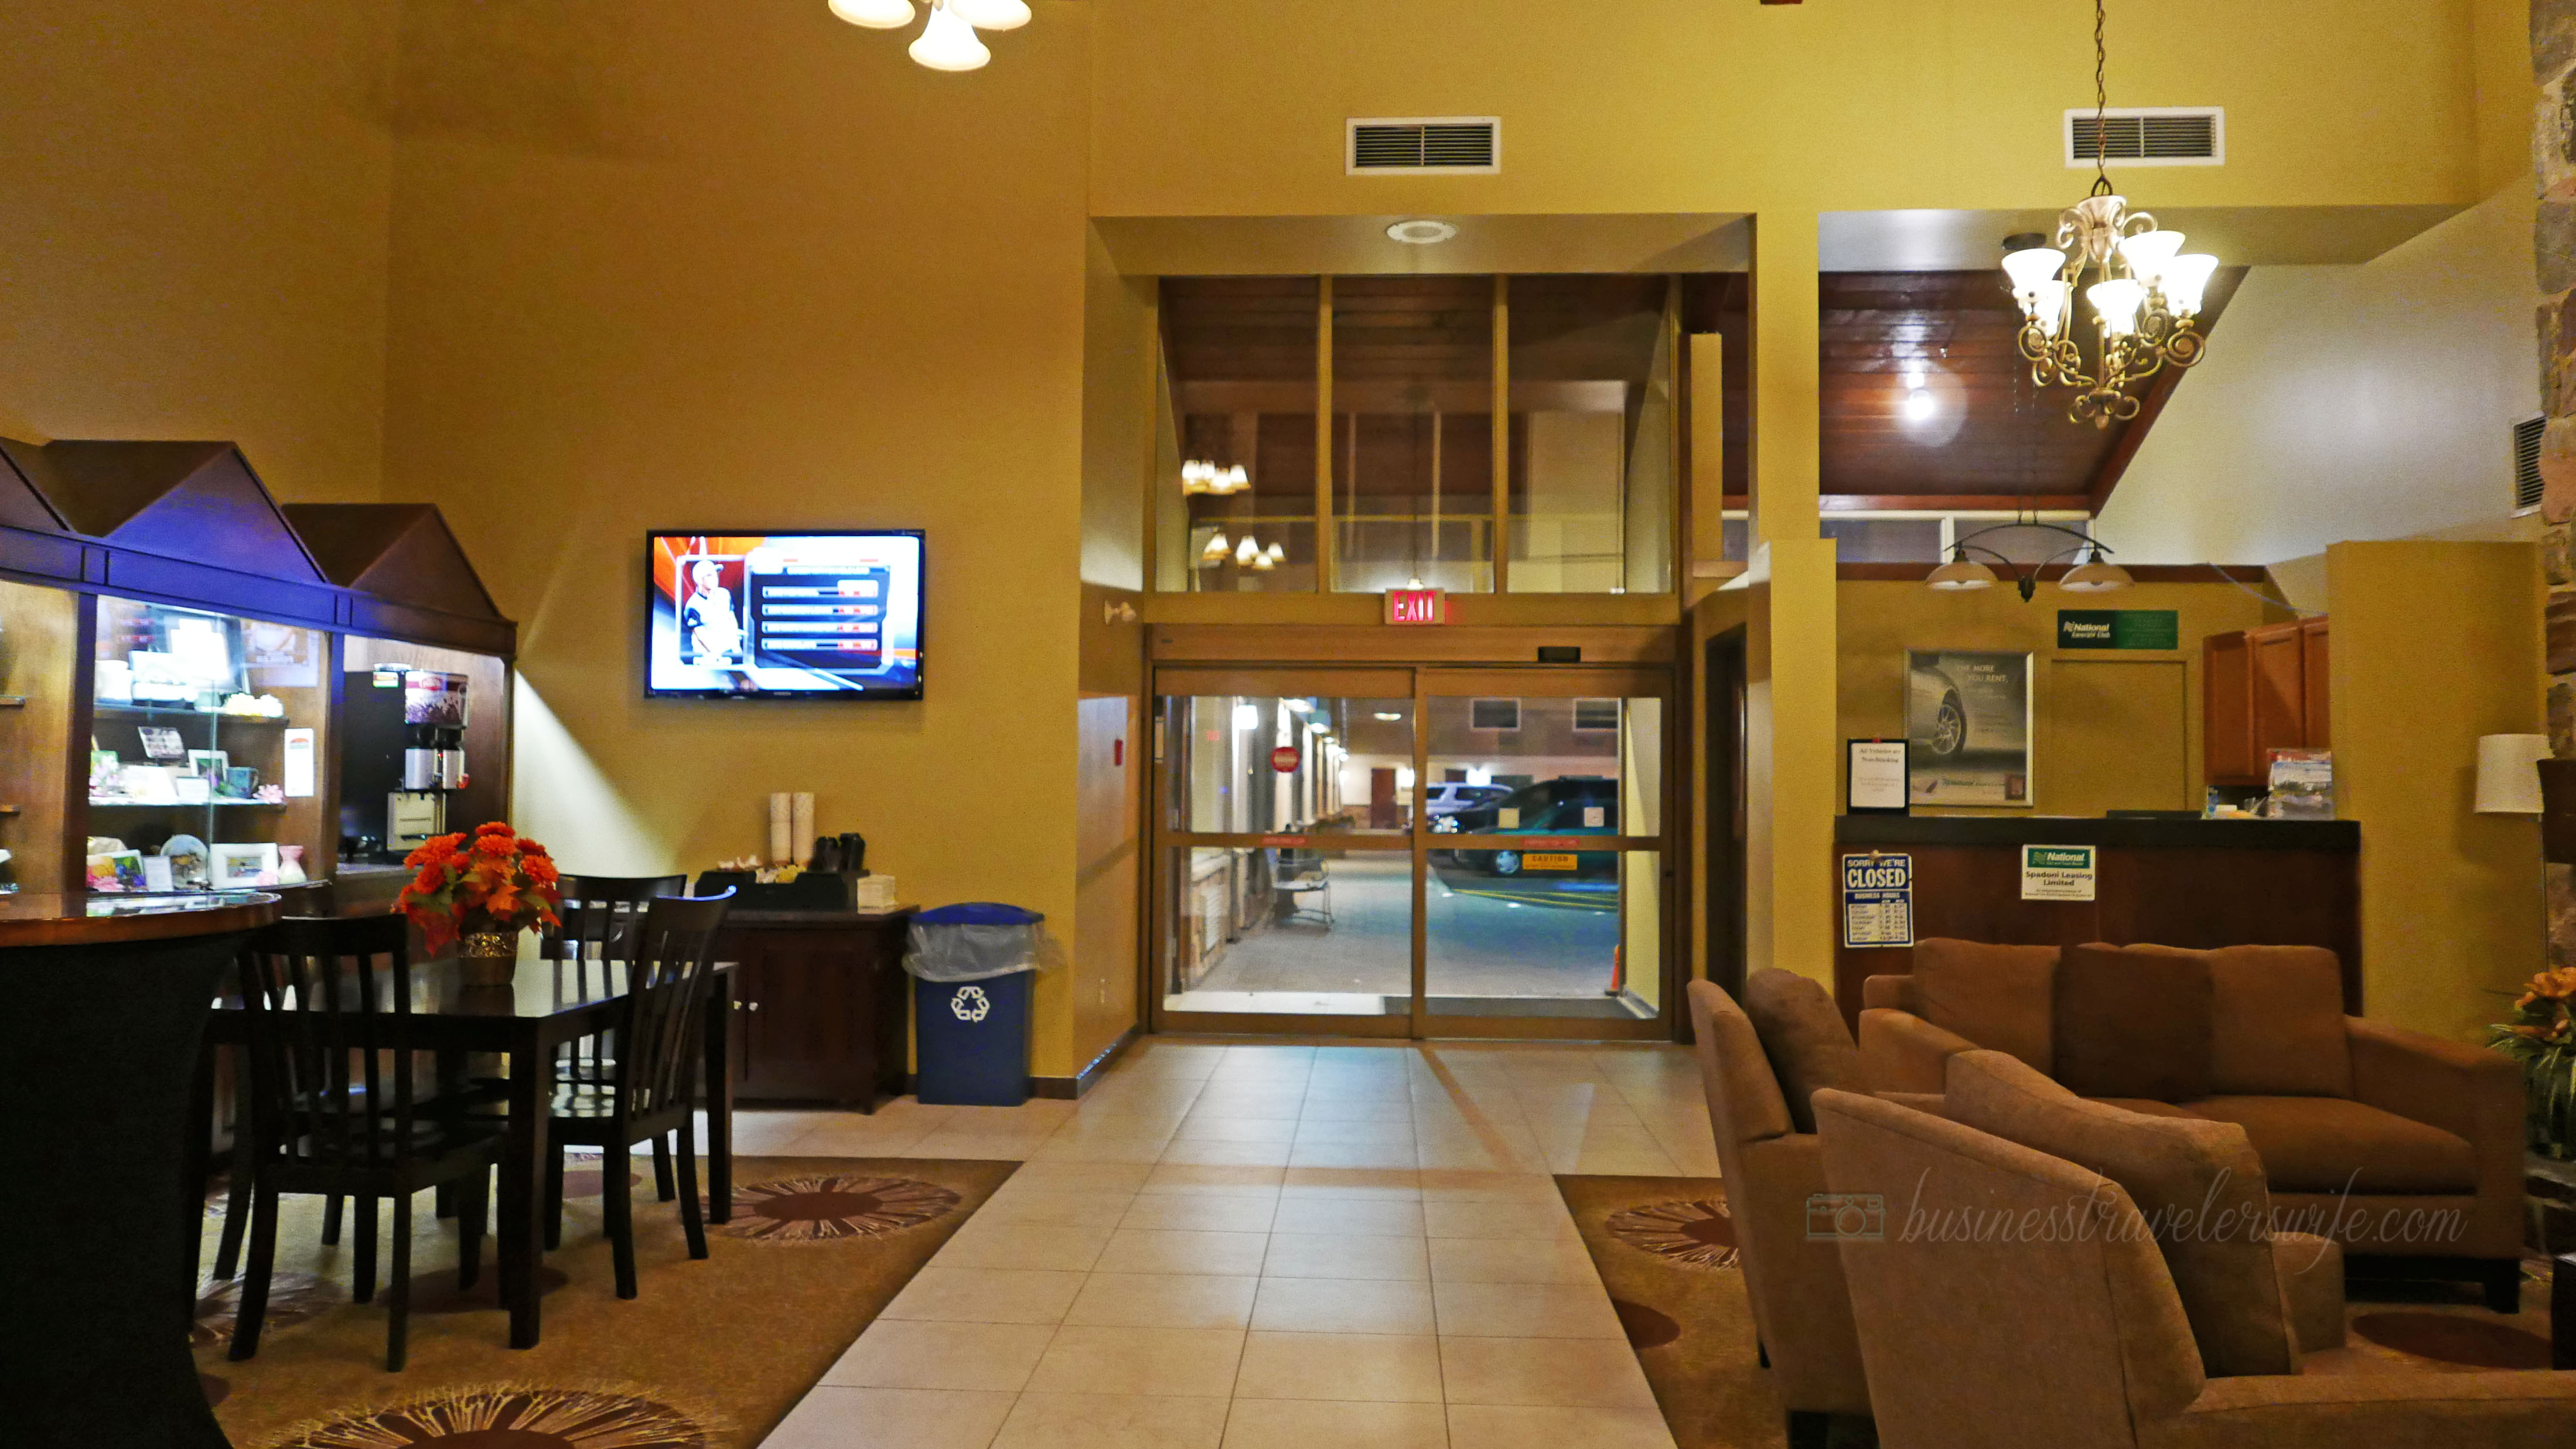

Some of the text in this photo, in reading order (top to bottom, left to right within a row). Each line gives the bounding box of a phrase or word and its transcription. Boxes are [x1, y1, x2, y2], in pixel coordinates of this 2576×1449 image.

[1393, 590, 1437, 622] EXIT
[2074, 623, 2110, 632] National
[2047, 851, 2085, 861] National
[1847, 858, 1906, 867] SORRY WE'RE
[1847, 868, 1906, 888] CLOSED
[2062, 871, 2093, 881] Leasing
